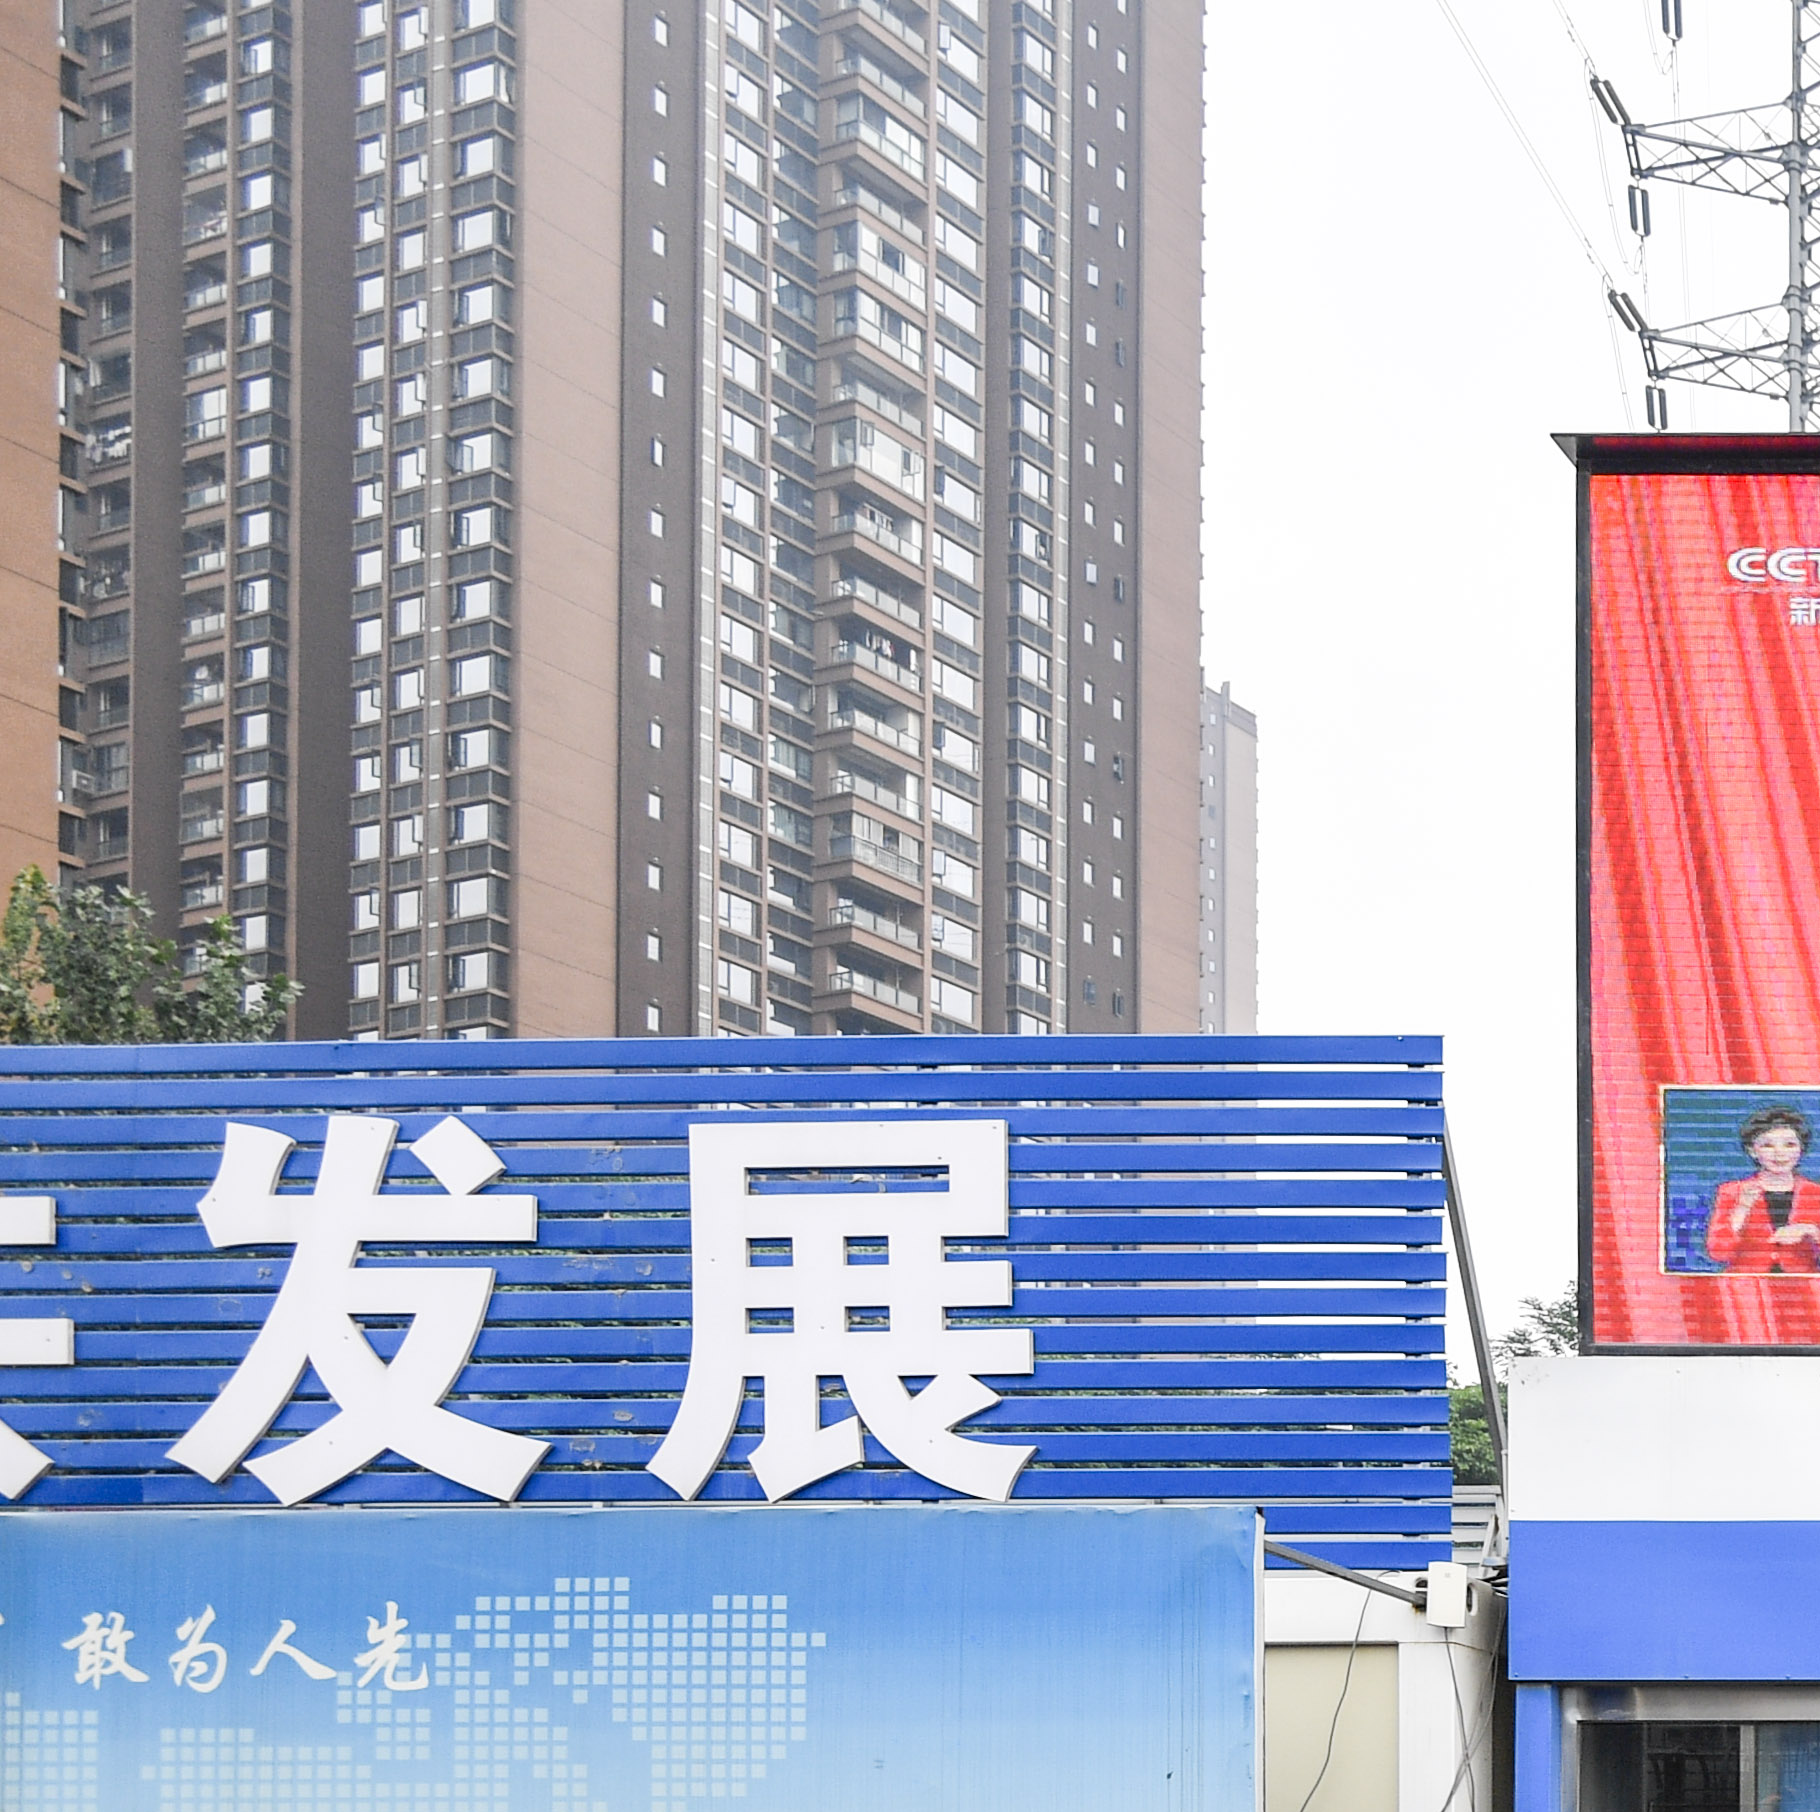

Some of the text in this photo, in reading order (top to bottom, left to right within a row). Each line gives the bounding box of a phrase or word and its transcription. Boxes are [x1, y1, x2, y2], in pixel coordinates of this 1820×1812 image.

[0, 1115, 1038, 1503] 发展
[61, 1600, 429, 1694] 敢为人先
